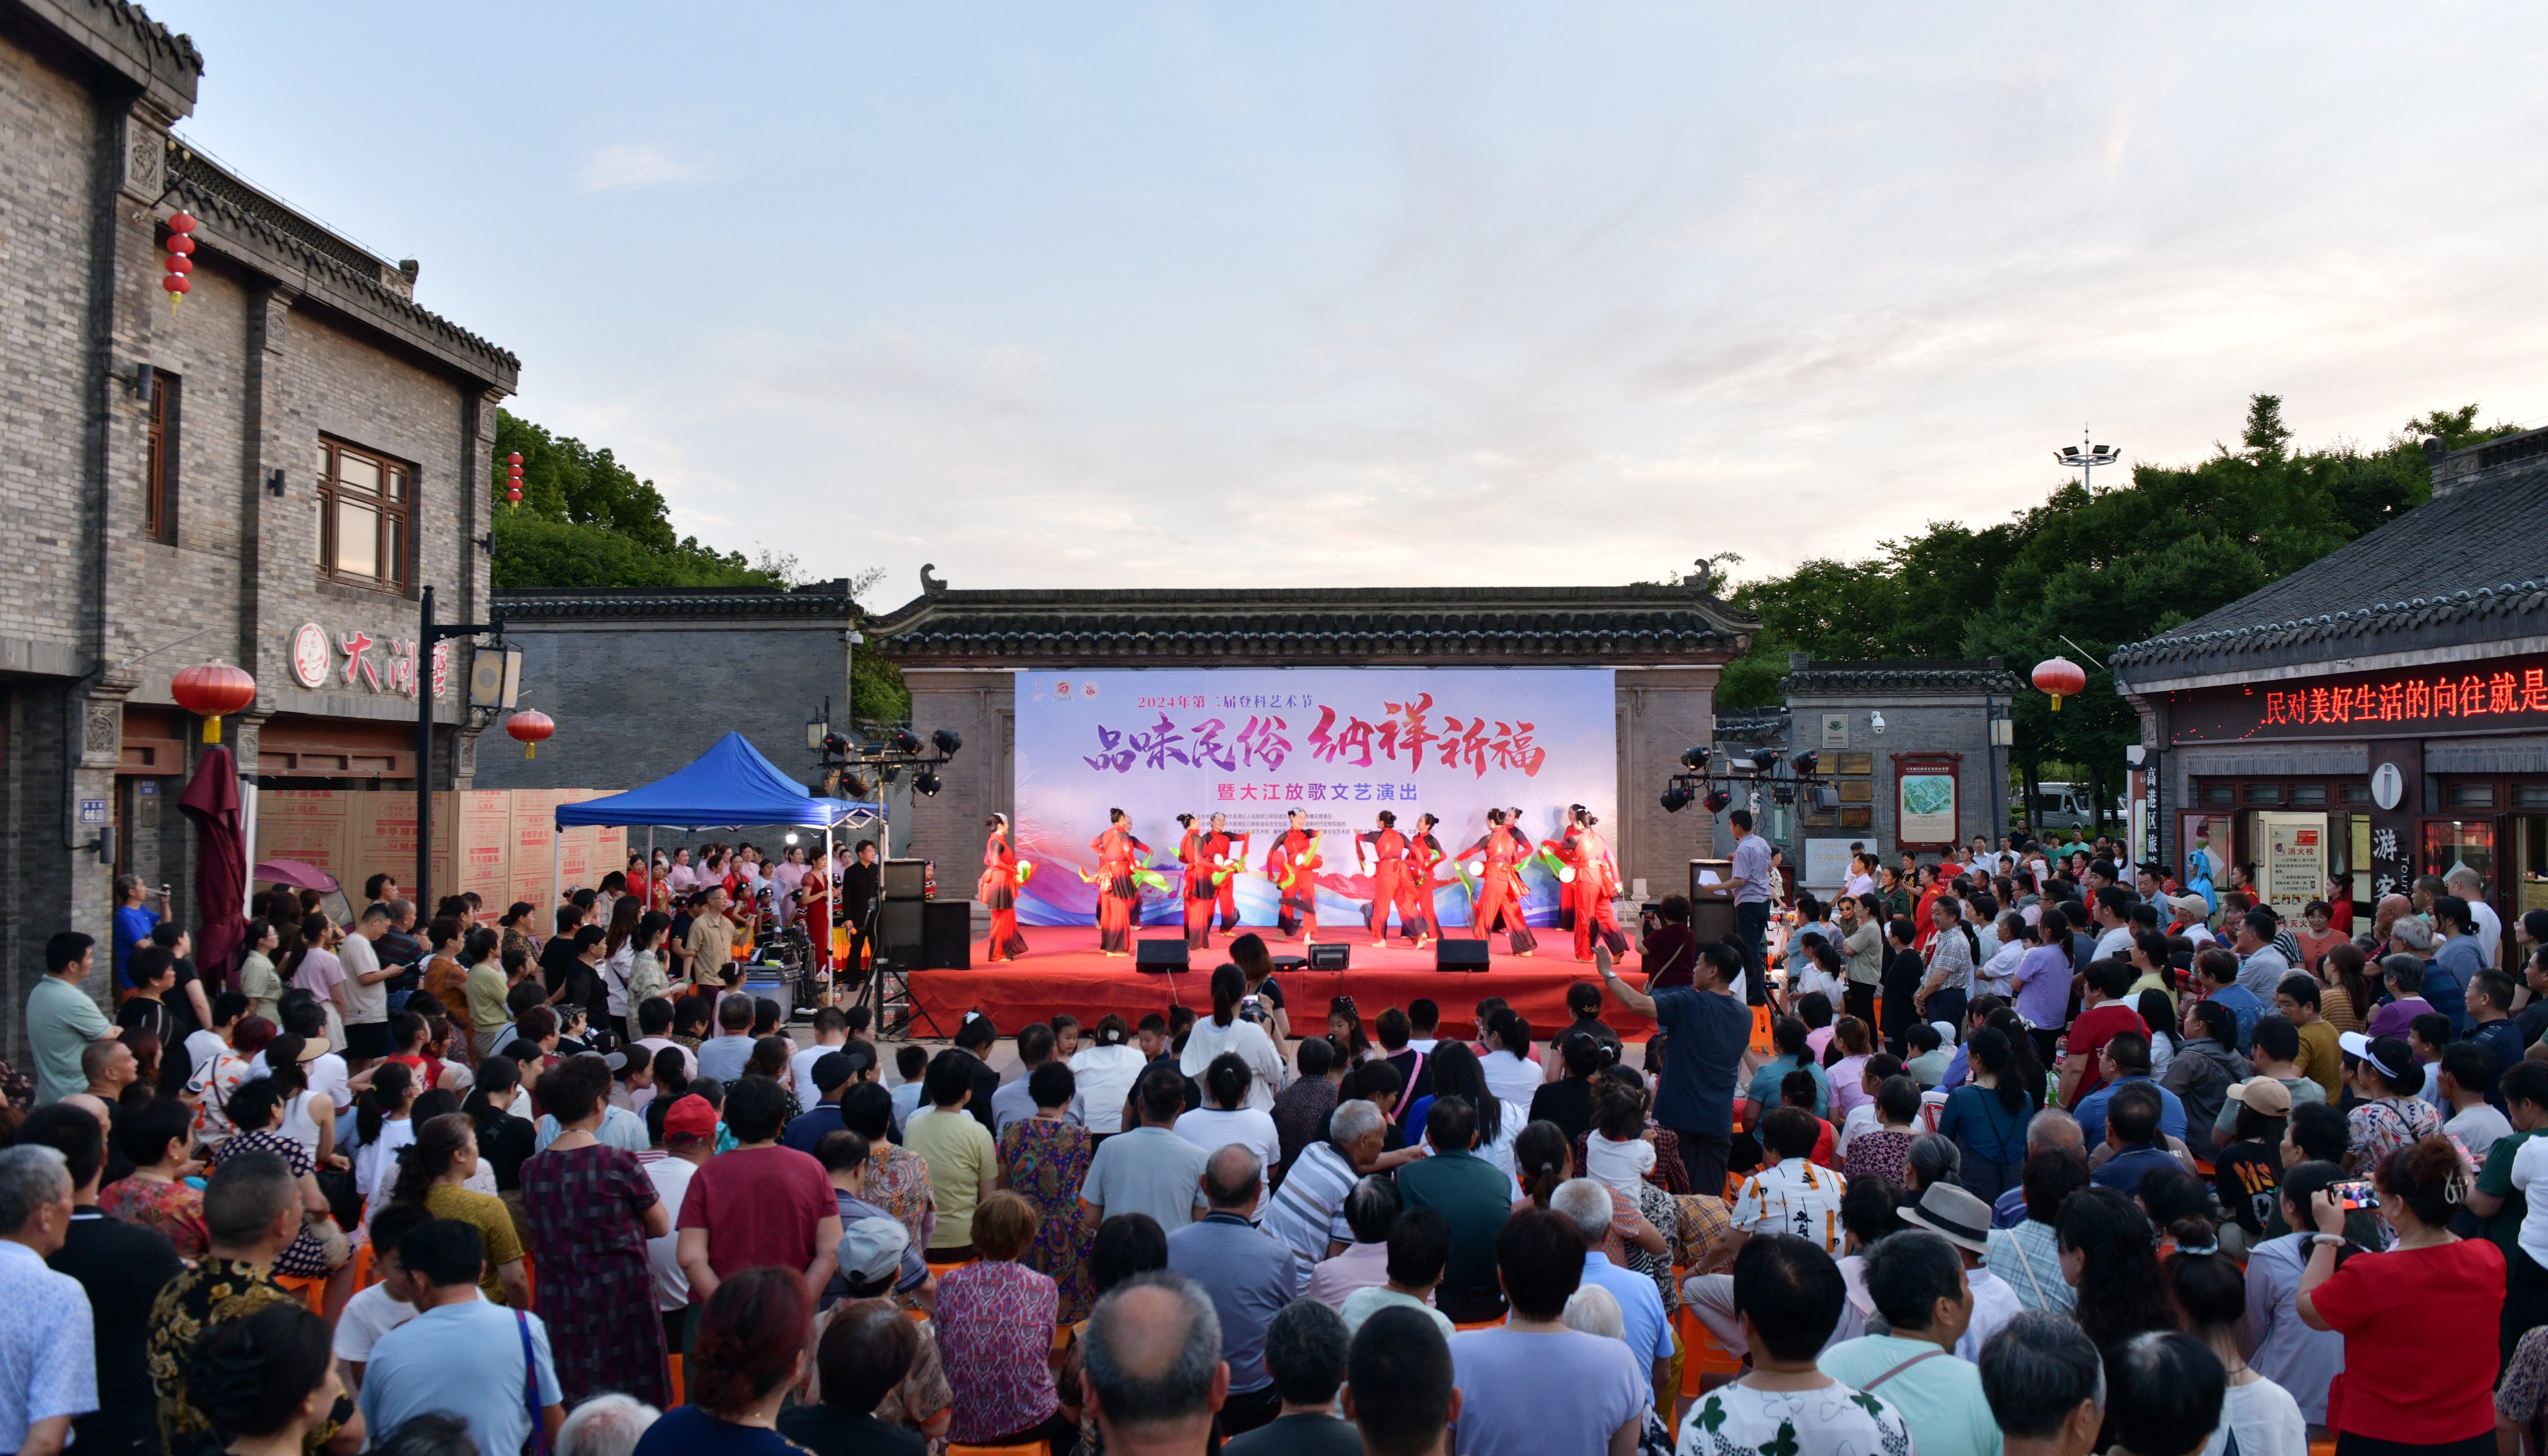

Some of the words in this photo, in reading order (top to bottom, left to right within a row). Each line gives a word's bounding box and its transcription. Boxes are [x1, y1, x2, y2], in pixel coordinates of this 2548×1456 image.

[1137, 694, 1313, 709] 2024年第二届登科艺术节
[2267, 669, 2548, 724] 民对美好生活的向往就是
[1083, 711, 1293, 774] 品味民俗
[1308, 692, 1546, 781] 纳祥祈福
[1217, 783, 1417, 801] 暨大江放歌文艺演出
[2373, 828, 2397, 901] 游客
[2401, 854, 2411, 894] Touri
